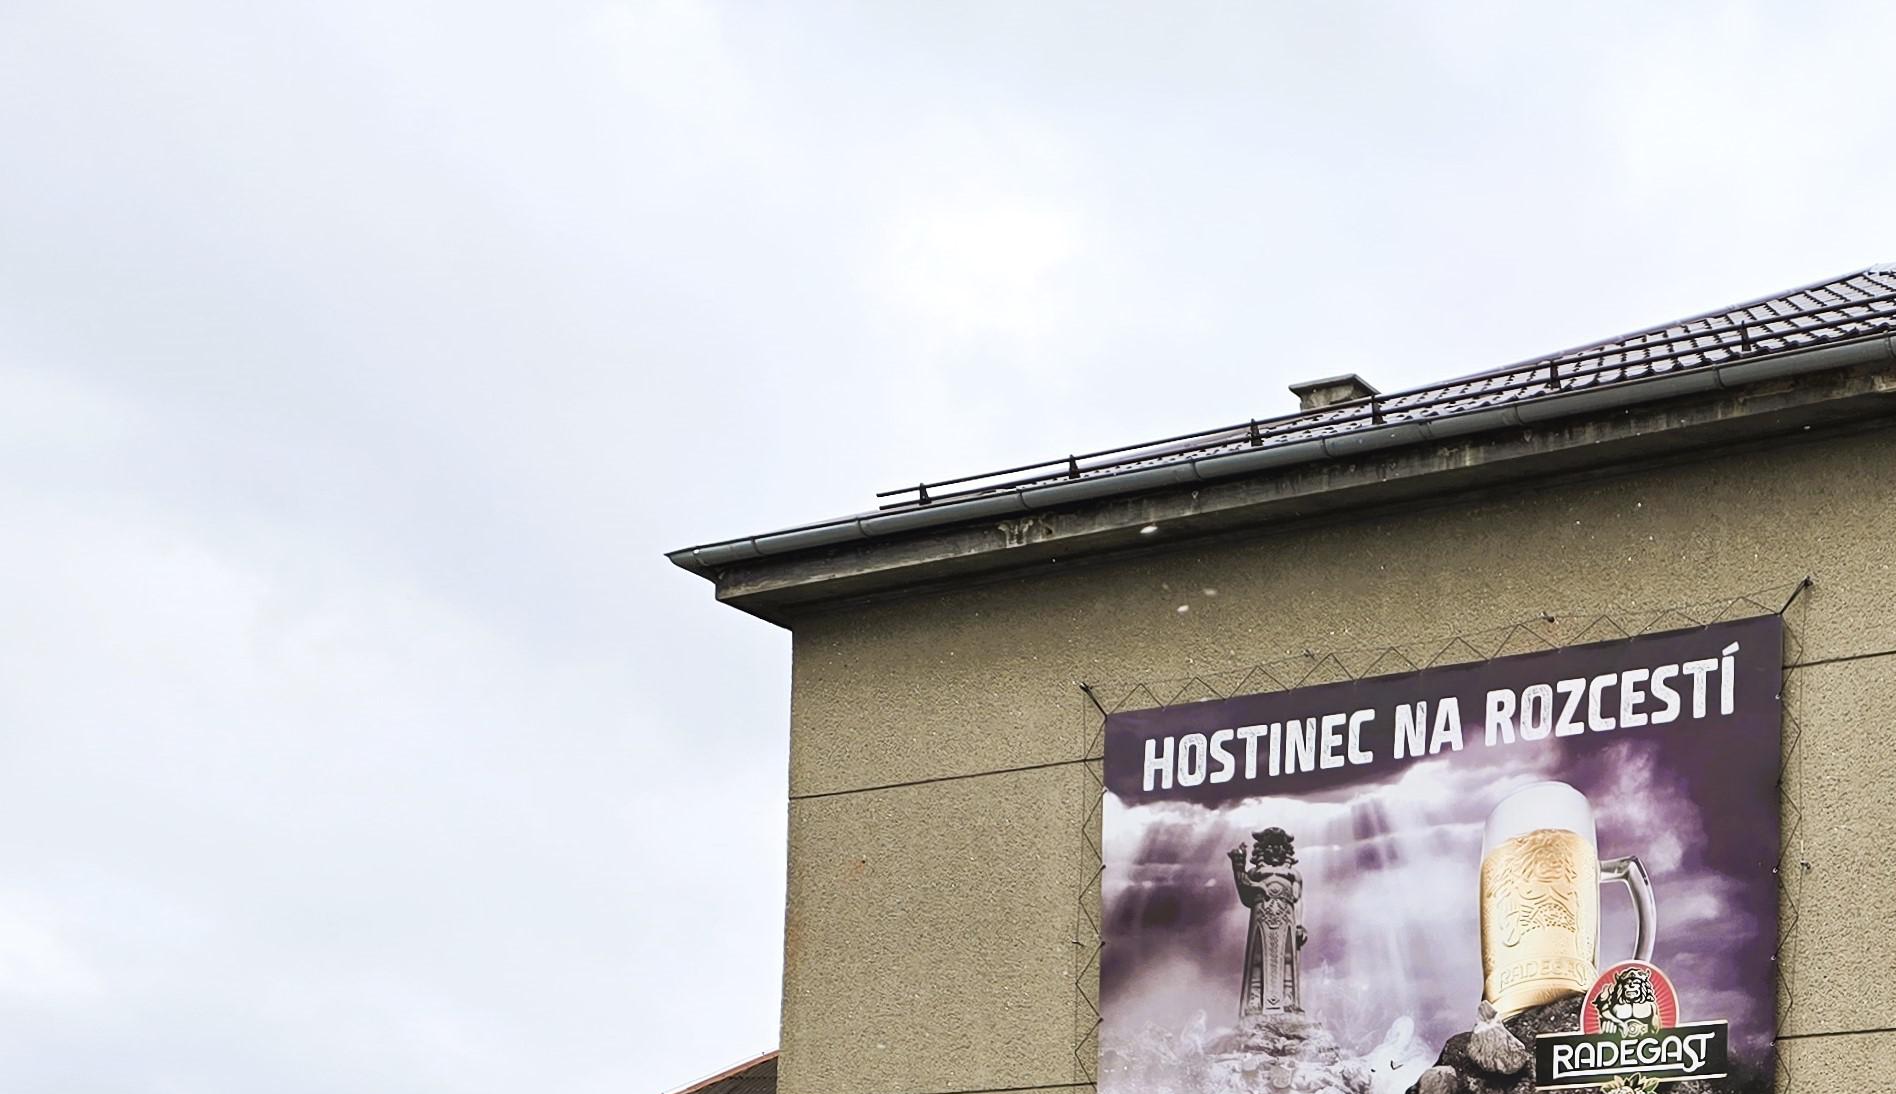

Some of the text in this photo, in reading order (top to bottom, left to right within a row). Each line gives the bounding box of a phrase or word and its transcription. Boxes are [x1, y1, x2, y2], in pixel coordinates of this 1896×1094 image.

[1142, 641, 1740, 792] HOSTINEC NA ROZCESTÍ
[1553, 1032, 1715, 1079] RADEGAST
